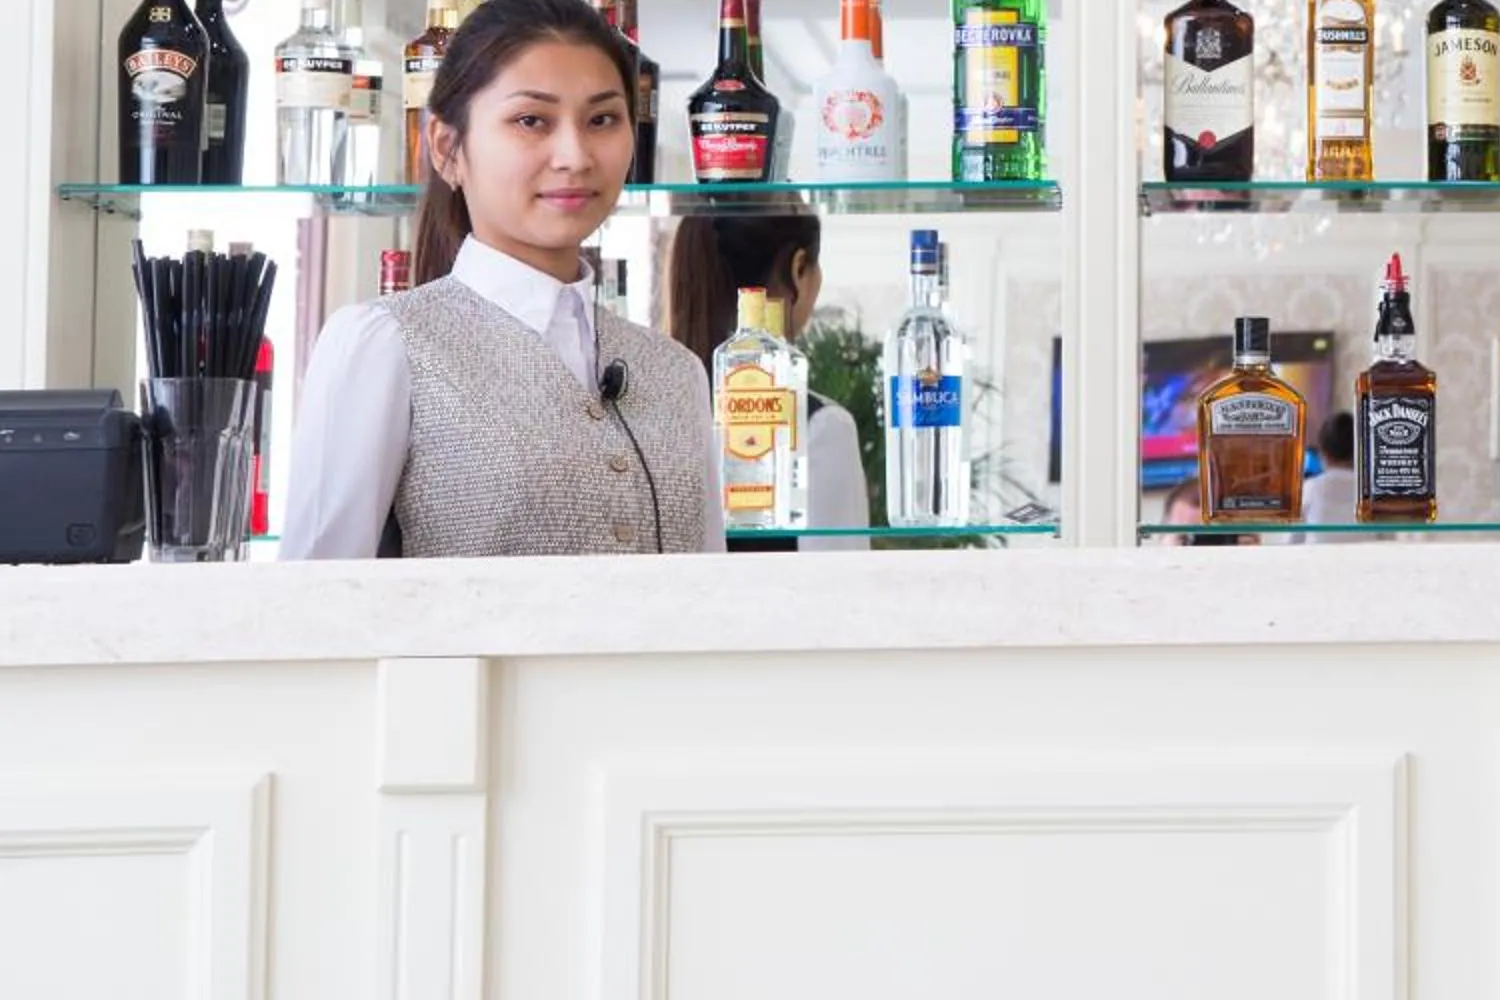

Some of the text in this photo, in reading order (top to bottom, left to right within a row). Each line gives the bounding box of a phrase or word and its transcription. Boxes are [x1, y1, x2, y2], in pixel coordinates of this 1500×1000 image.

[1433, 37, 1499, 57] JAMESON
[726, 397, 783, 413] ORDON'S
[1368, 406, 1392, 427] JACK
